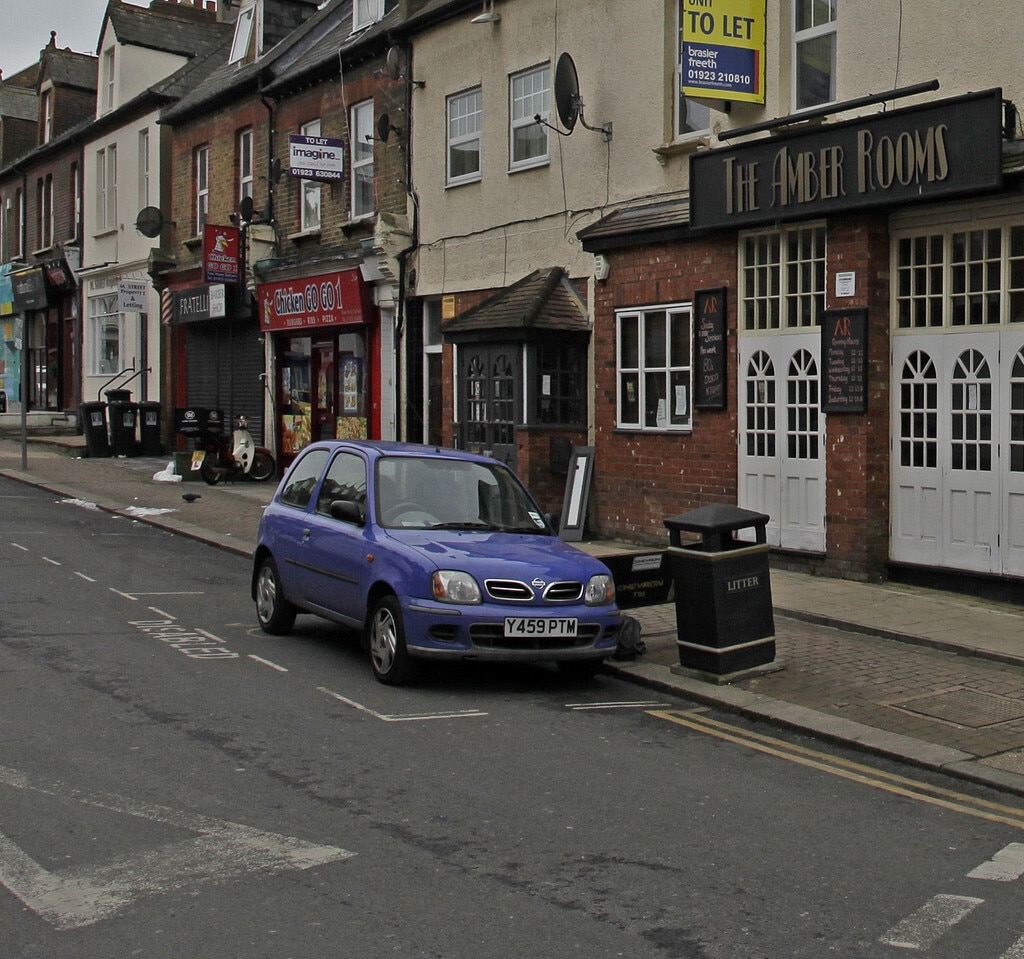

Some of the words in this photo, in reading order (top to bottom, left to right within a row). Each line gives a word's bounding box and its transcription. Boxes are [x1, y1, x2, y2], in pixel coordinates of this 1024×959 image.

[688, 11, 715, 35] TO
[723, 14, 754, 40] LET
[688, 46, 719, 59] brasier
[688, 57, 717, 69] freeth
[688, 69, 716, 81] 01923
[717, 72, 751, 85] 210810
[315, 170, 341, 178] 630844
[723, 157, 760, 214] THE
[770, 145, 847, 208] AMBER
[857, 124, 949, 193] ROOMS
[274, 287, 305, 316] Chicken
[305, 284, 319, 312] GO
[320, 281, 334, 310] GO
[335, 276, 343, 309] 1
[180, 294, 209, 315] FRATELLI
[322, 315, 334, 323] PIZZA
[617, 579, 664, 592] CHEVRON
[727, 576, 759, 591] LITTER
[506, 619, 546, 634] Y459
[548, 619, 576, 634] PTM
[128, 619, 240, 659] DISABLED
